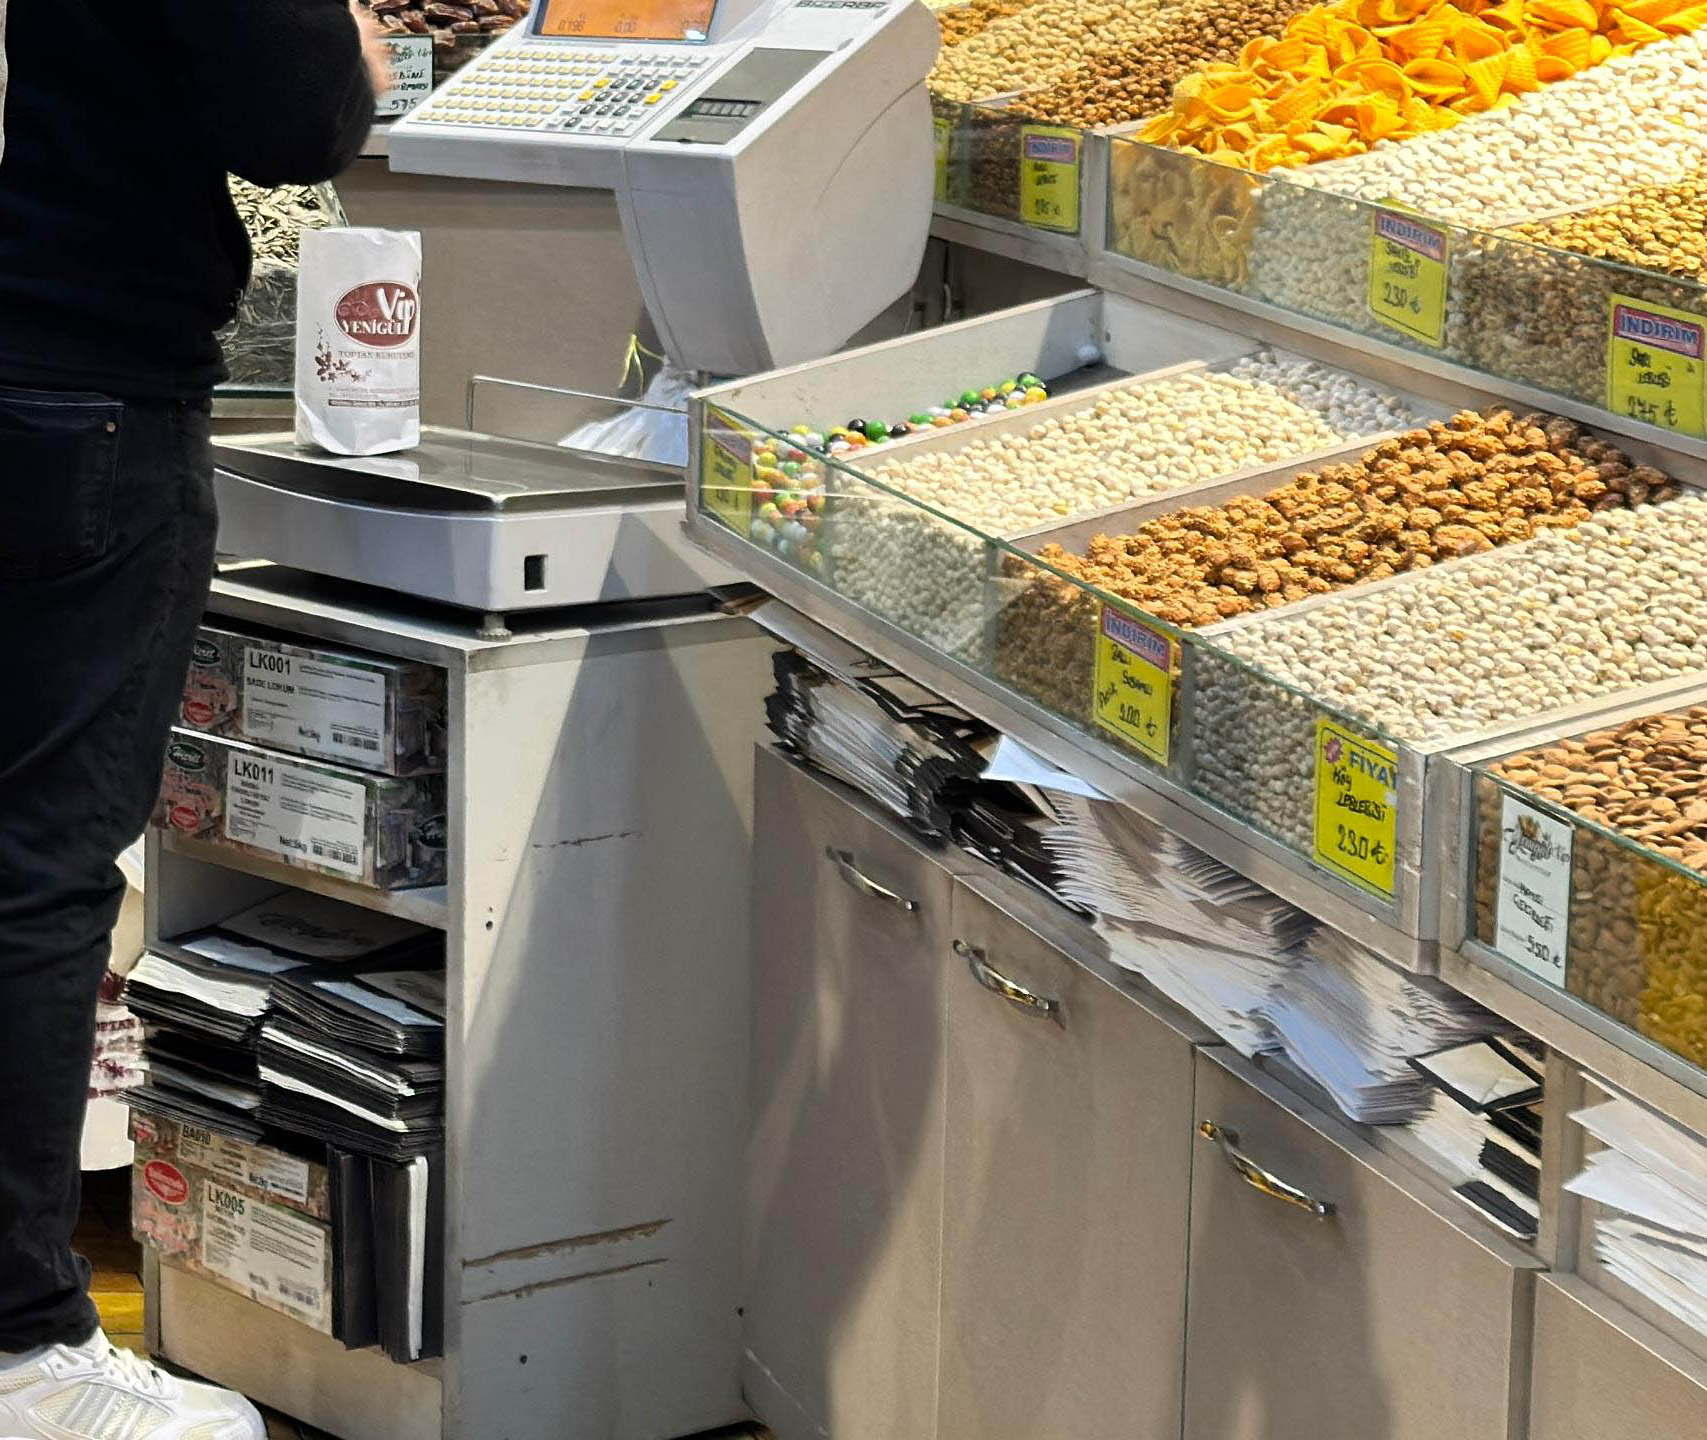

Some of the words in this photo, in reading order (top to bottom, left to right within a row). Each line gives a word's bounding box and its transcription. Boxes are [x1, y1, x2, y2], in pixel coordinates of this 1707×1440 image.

[340, 318, 410, 335] YENİGÜL
[1620, 313, 1699, 346] İNDİRİM
[249, 650, 292, 675] LK001
[234, 759, 275, 785] LK011
[208, 1182, 246, 1216] LK005
